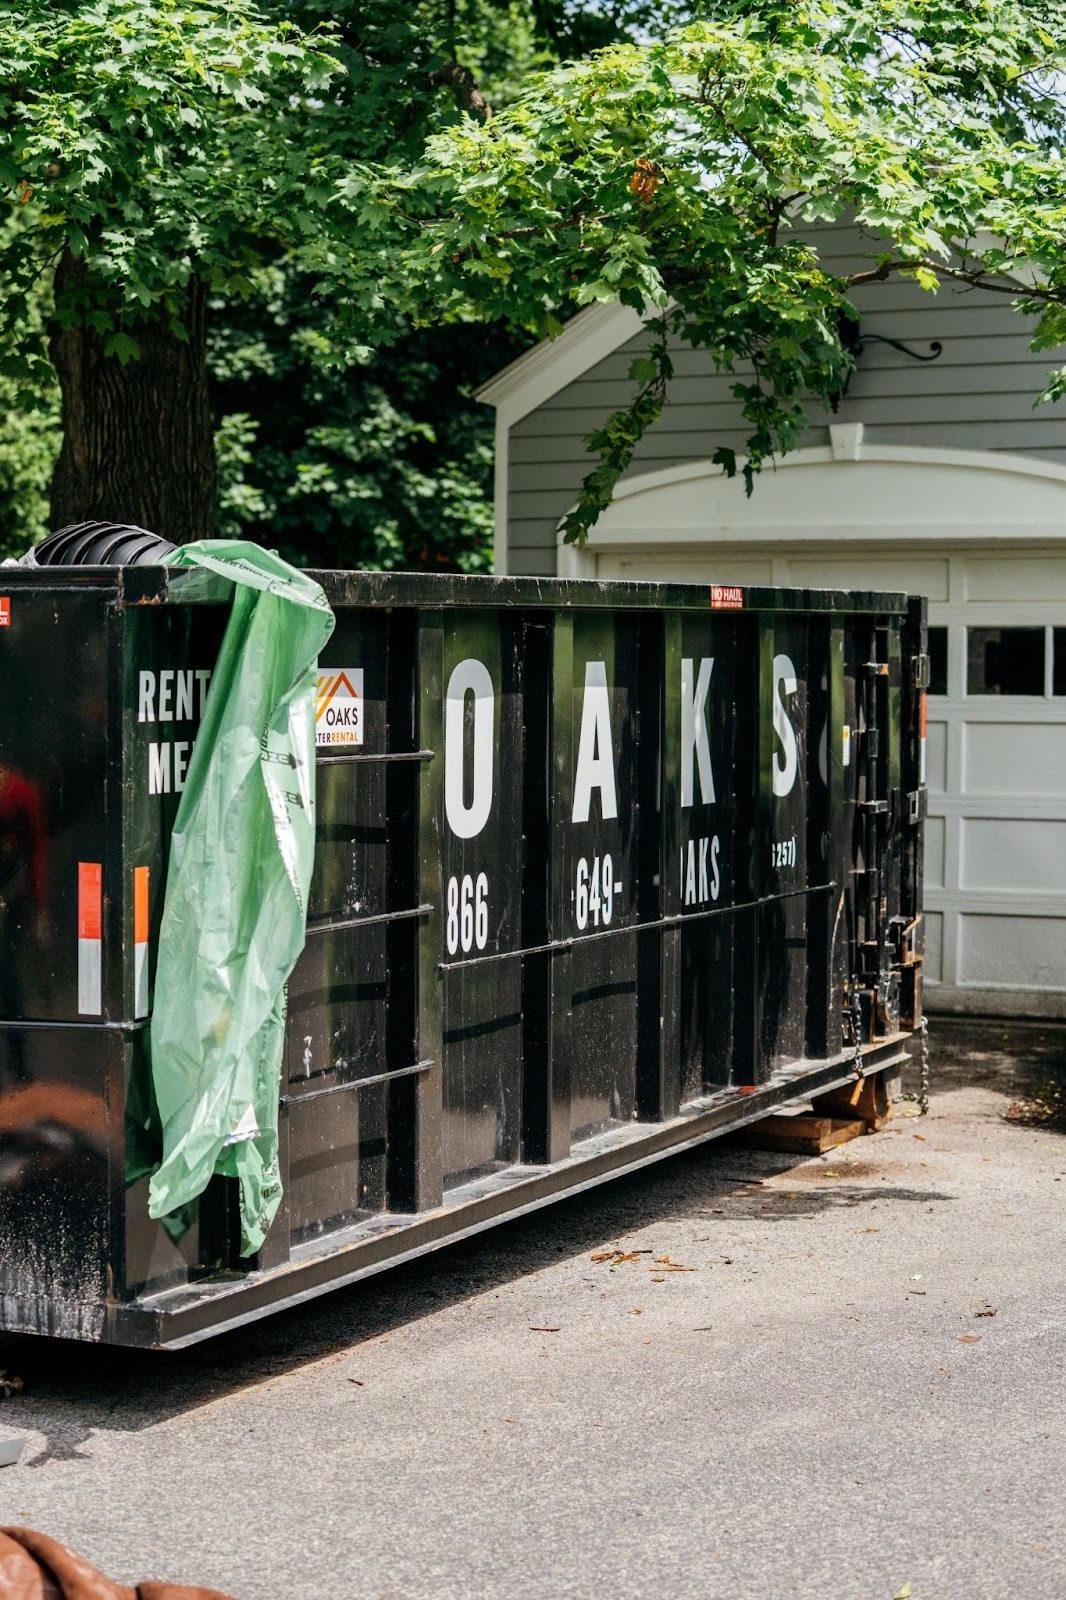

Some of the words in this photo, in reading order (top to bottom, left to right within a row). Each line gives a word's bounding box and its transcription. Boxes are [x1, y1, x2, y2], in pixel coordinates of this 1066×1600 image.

[711, 587, 723, 601] NO
[723, 587, 743, 602] HAUL
[138, 669, 211, 723] RENT
[326, 707, 359, 727] OAKS
[148, 741, 197, 795] ME
[446, 871, 489, 955] 866
[680, 834, 720, 906] AKS
